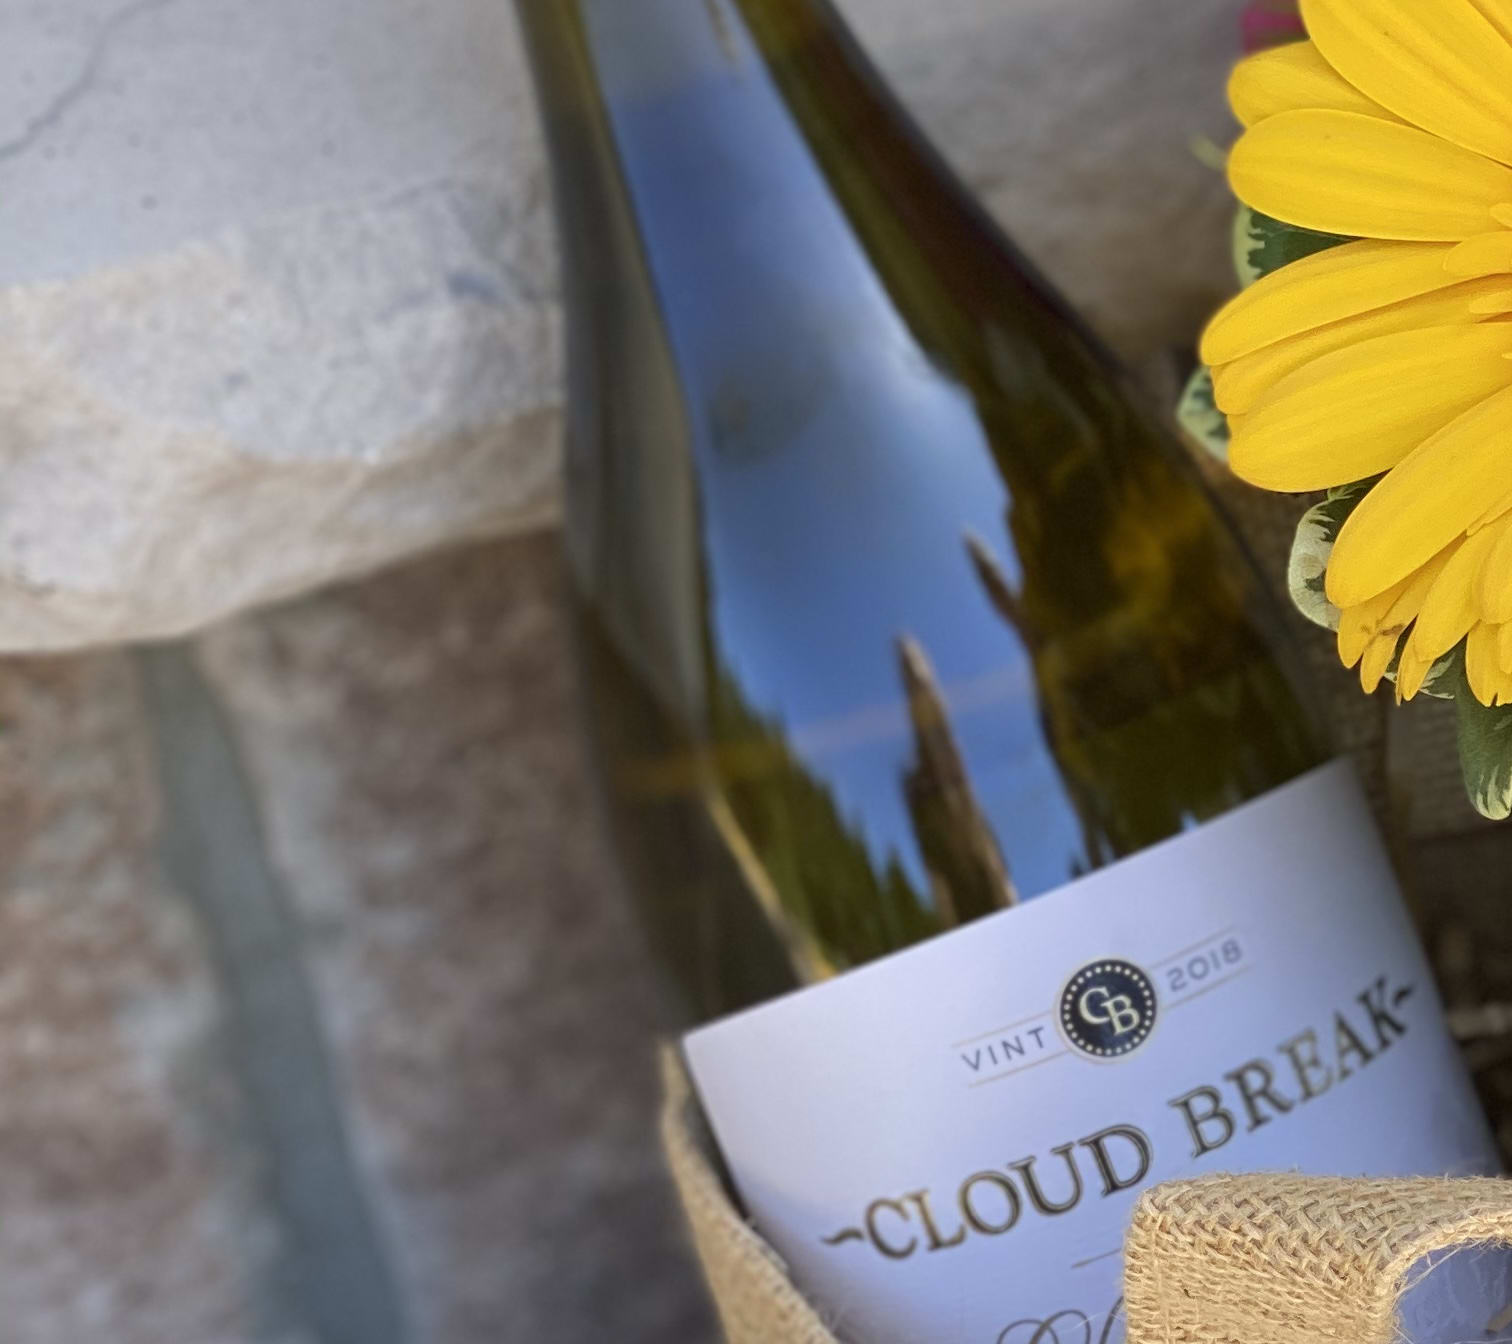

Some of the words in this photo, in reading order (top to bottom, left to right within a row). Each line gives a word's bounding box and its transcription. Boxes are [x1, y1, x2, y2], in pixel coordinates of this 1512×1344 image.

[961, 1026, 1046, 1072] VINT
[1166, 938, 1243, 992] 2018
[863, 1123, 1153, 1260] CLOUD
[1167, 974, 1409, 1159] BREAK
